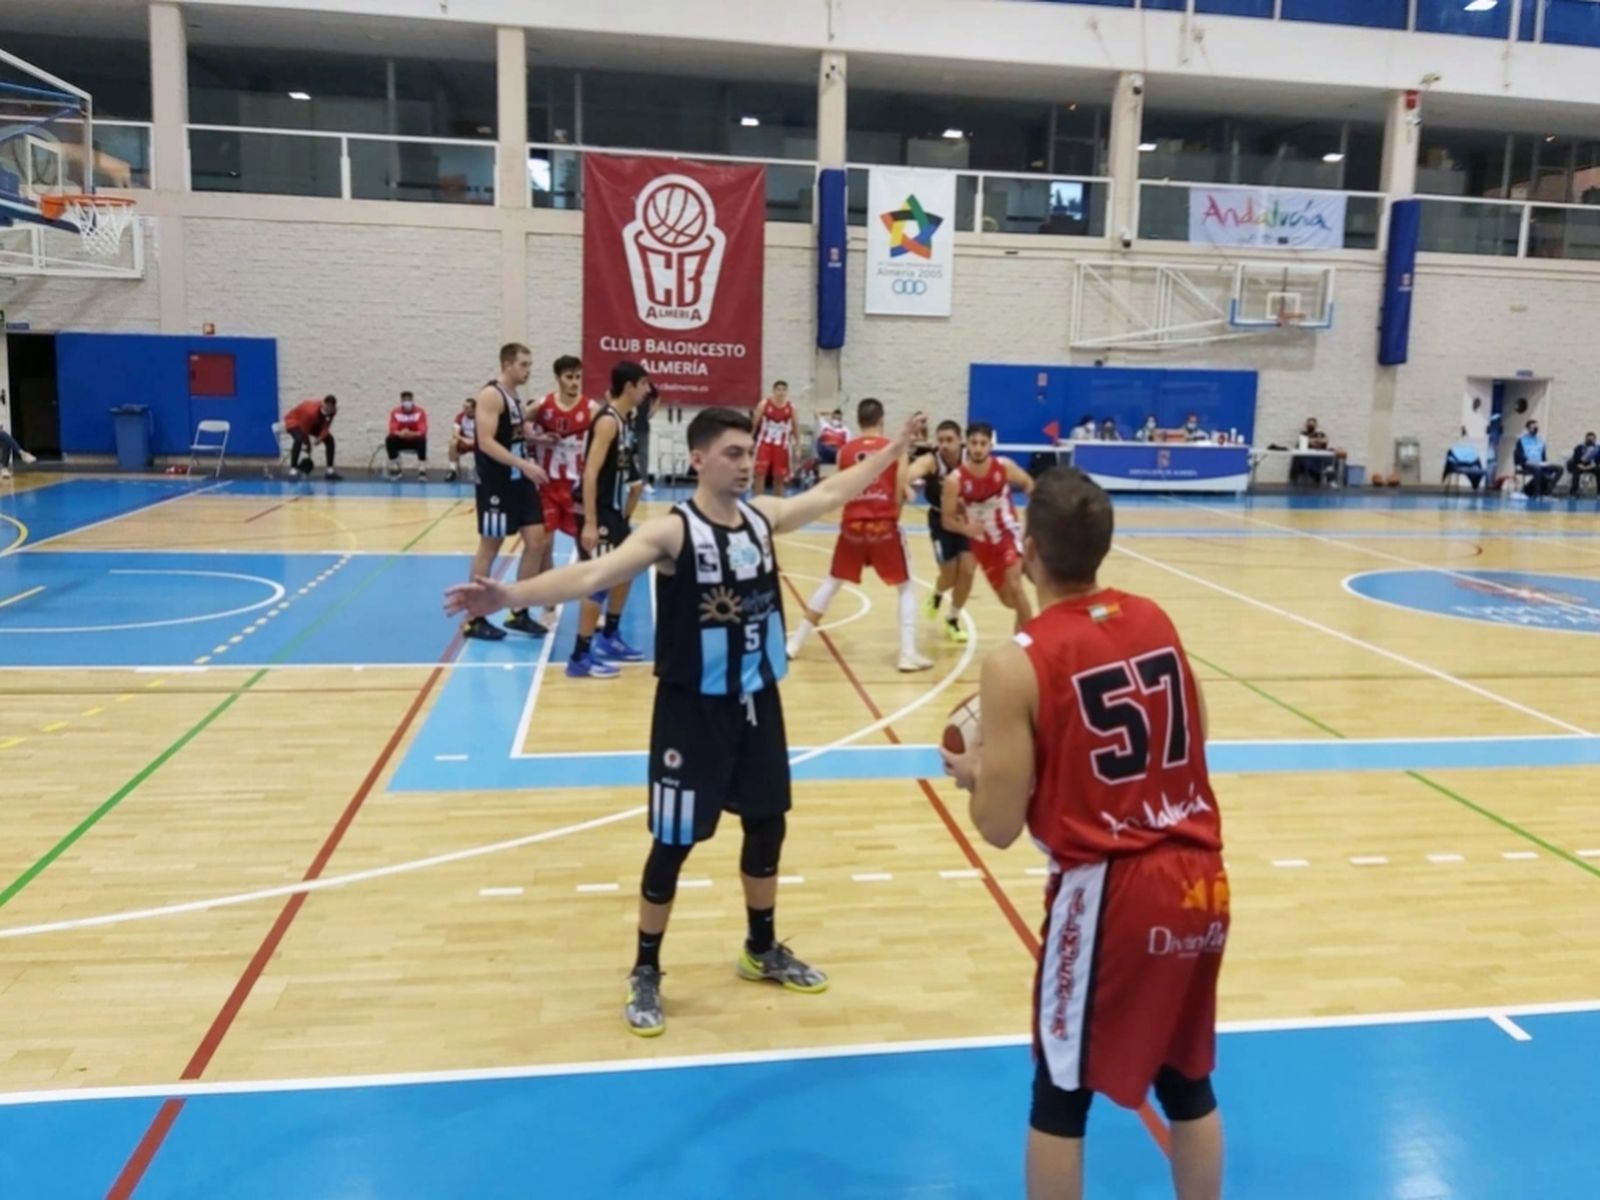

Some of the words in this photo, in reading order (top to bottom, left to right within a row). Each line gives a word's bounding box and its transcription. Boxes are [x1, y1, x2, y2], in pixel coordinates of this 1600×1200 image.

[1202, 194, 1332, 231] Andalucía
[600, 336, 641, 352] CLUB
[645, 338, 746, 358] BALONCESTO
[639, 358, 709, 376] ALMERÍA
[744, 623, 760, 651] 5
[1071, 646, 1190, 785] 57
